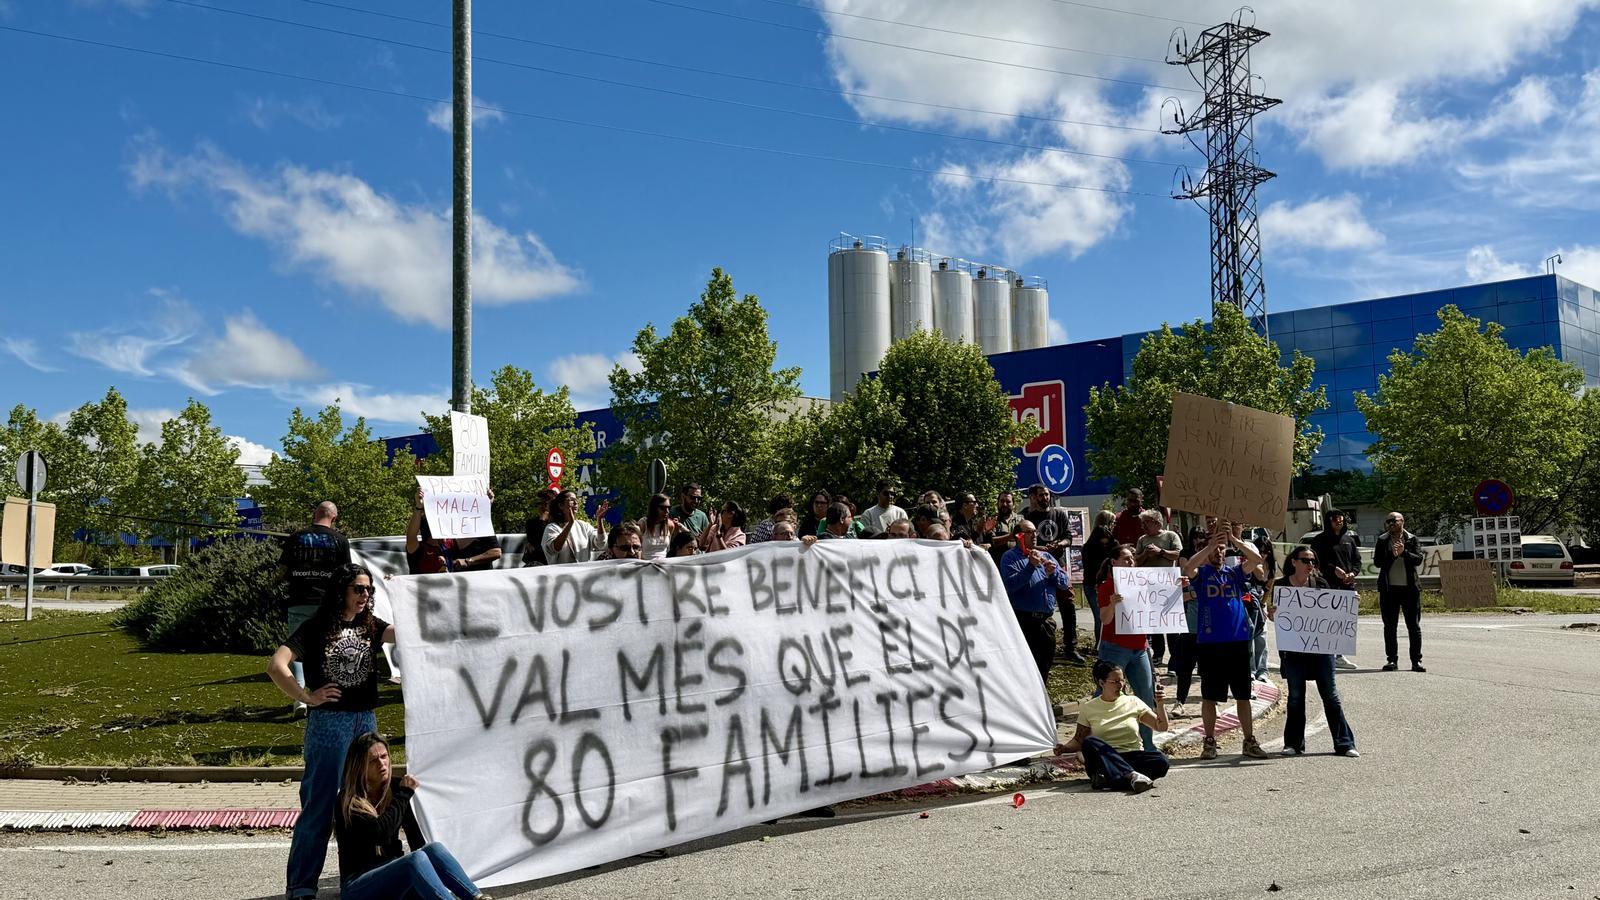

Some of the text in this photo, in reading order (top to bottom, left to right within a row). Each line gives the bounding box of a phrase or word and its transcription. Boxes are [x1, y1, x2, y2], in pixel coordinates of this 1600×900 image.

[460, 415, 478, 449] 80
[1176, 448, 1201, 469] NO
[1210, 456, 1239, 477] VAL
[436, 497, 480, 515] MALA
[1174, 472, 1199, 492] QUE
[1232, 485, 1253, 501] DE
[1257, 490, 1284, 517] 80
[438, 516, 481, 537] LLET
[1119, 569, 1178, 587] PASCUAL
[416, 575, 500, 642] EL
[514, 562, 729, 630] VOSTRE
[747, 554, 926, 615] BENEFICI
[937, 548, 993, 610] NO
[1137, 588, 1169, 607] NOS
[1277, 586, 1360, 616] PASCUAL
[1120, 609, 1186, 631] MIENTE
[1277, 611, 1357, 638] SOLUCIONES
[458, 649, 601, 730] VAL
[616, 620, 748, 722] MÉS
[776, 624, 871, 696] QUE
[936, 615, 988, 671] DE
[519, 731, 615, 847] 80
